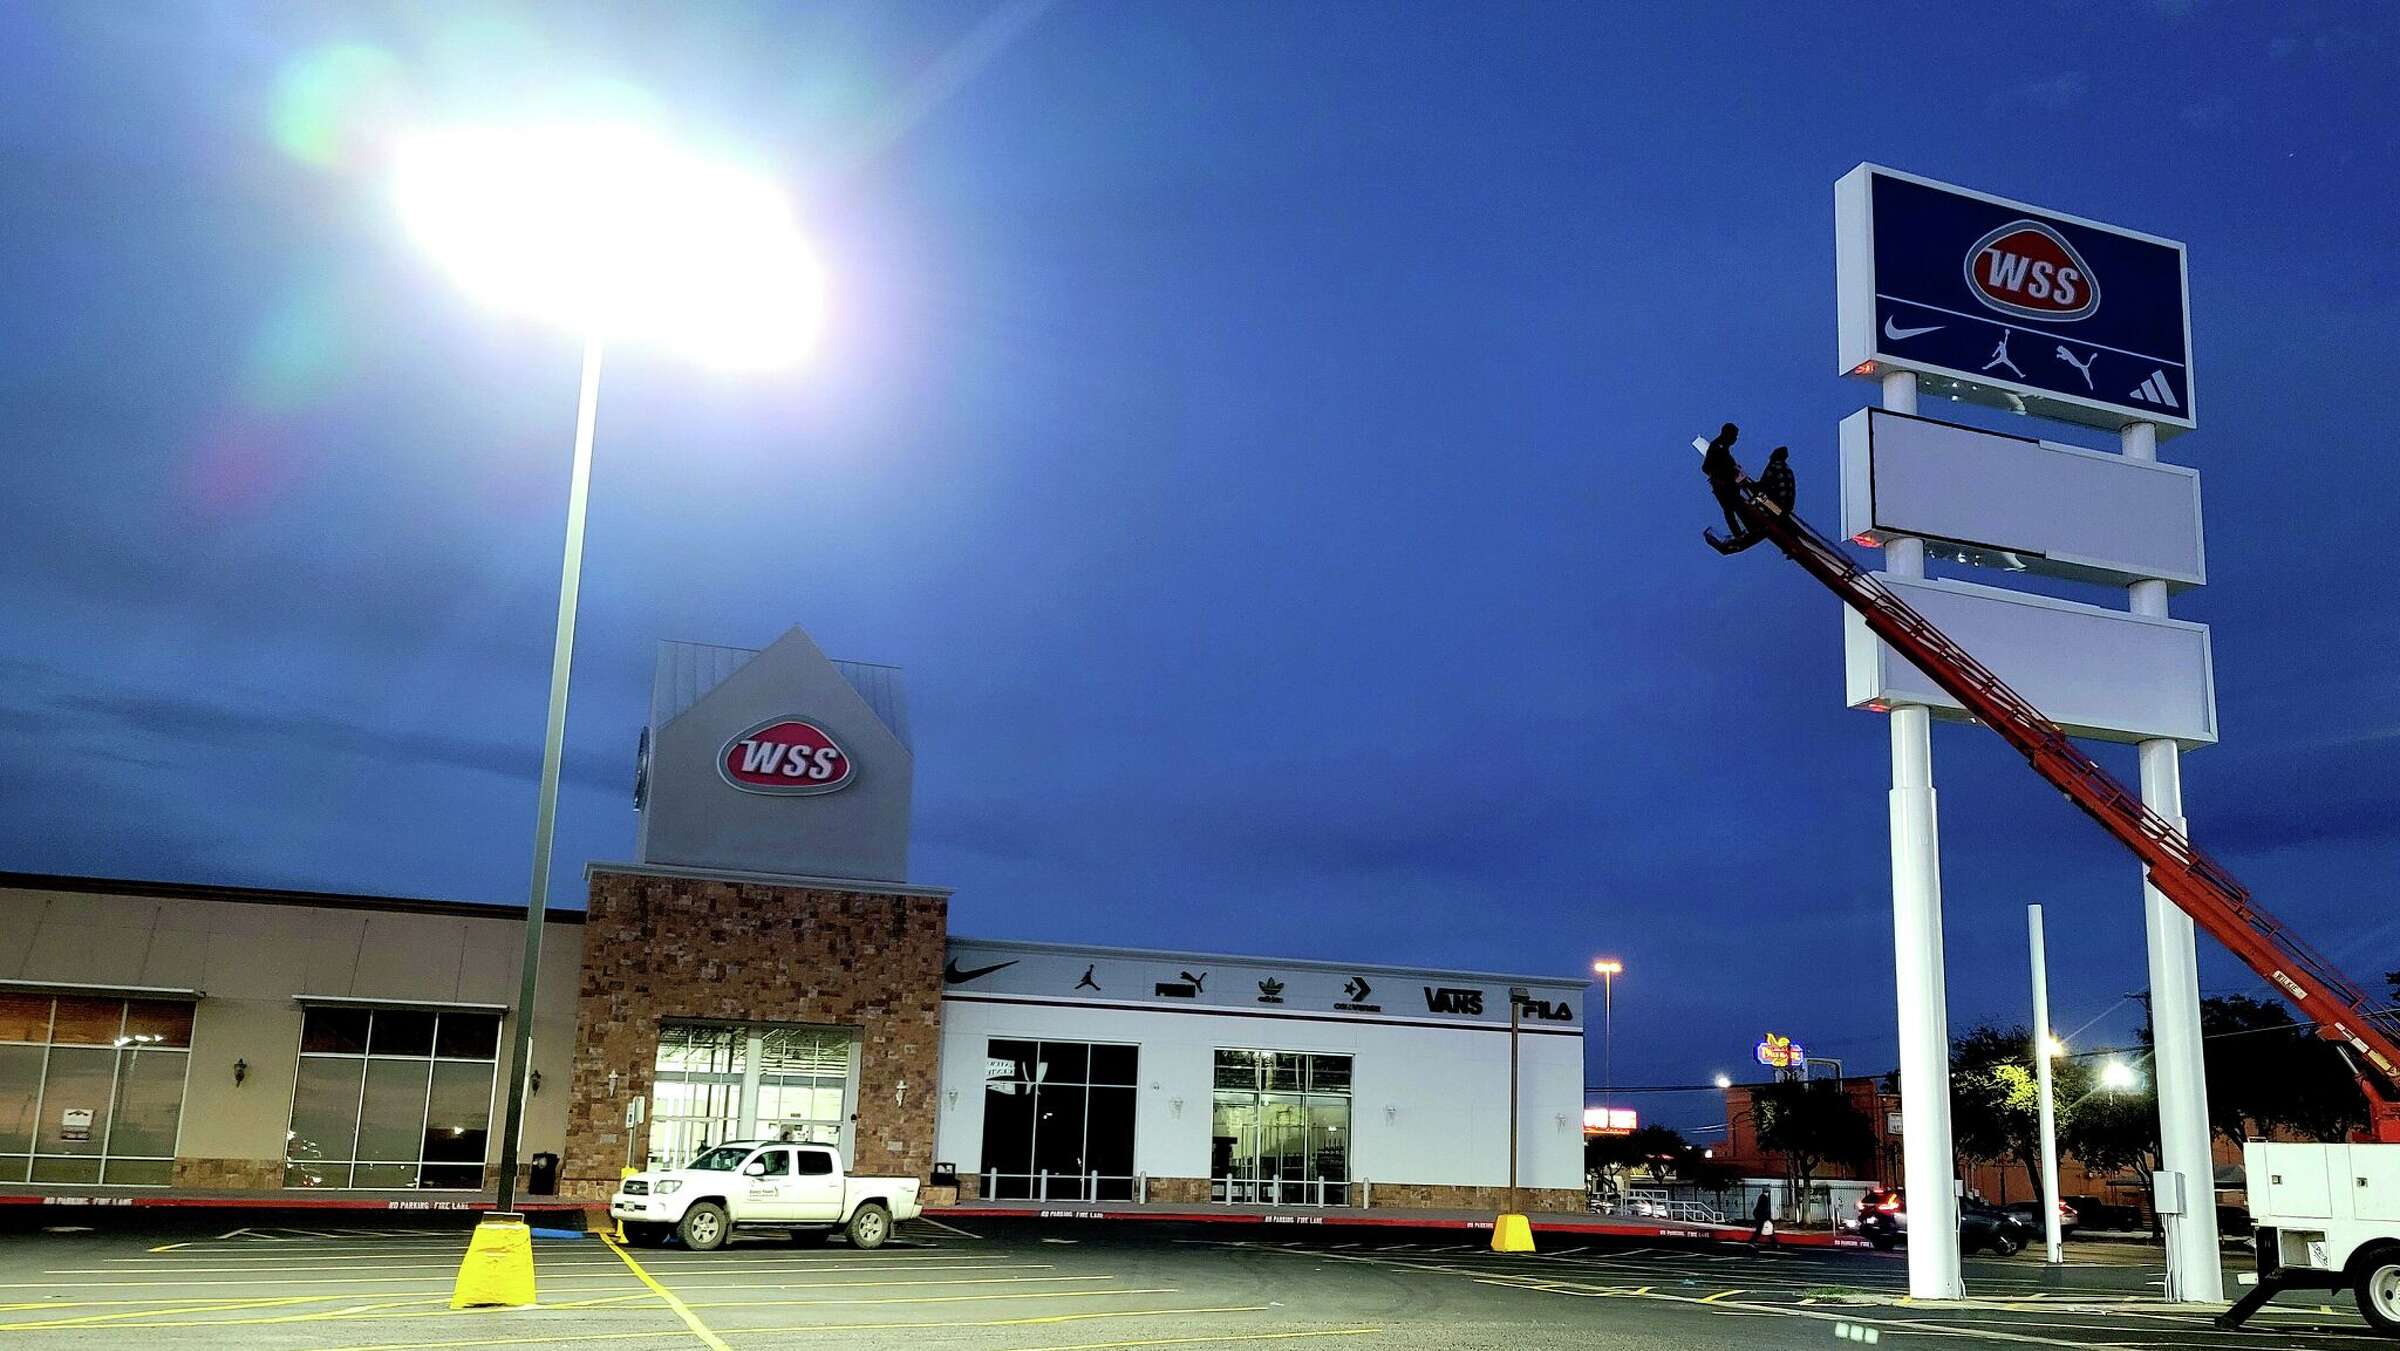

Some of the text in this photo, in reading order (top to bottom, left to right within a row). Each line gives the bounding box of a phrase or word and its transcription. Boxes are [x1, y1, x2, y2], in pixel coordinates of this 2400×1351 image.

[1983, 247, 2080, 305] WSS
[740, 740, 837, 779] WSS
[1424, 986, 1483, 1015] VANS
[1521, 1000, 1573, 1020] FILA
[388, 1201, 399, 1209] NO
[400, 1201, 430, 1210] PARKING
[433, 1201, 450, 1210] FIRE
